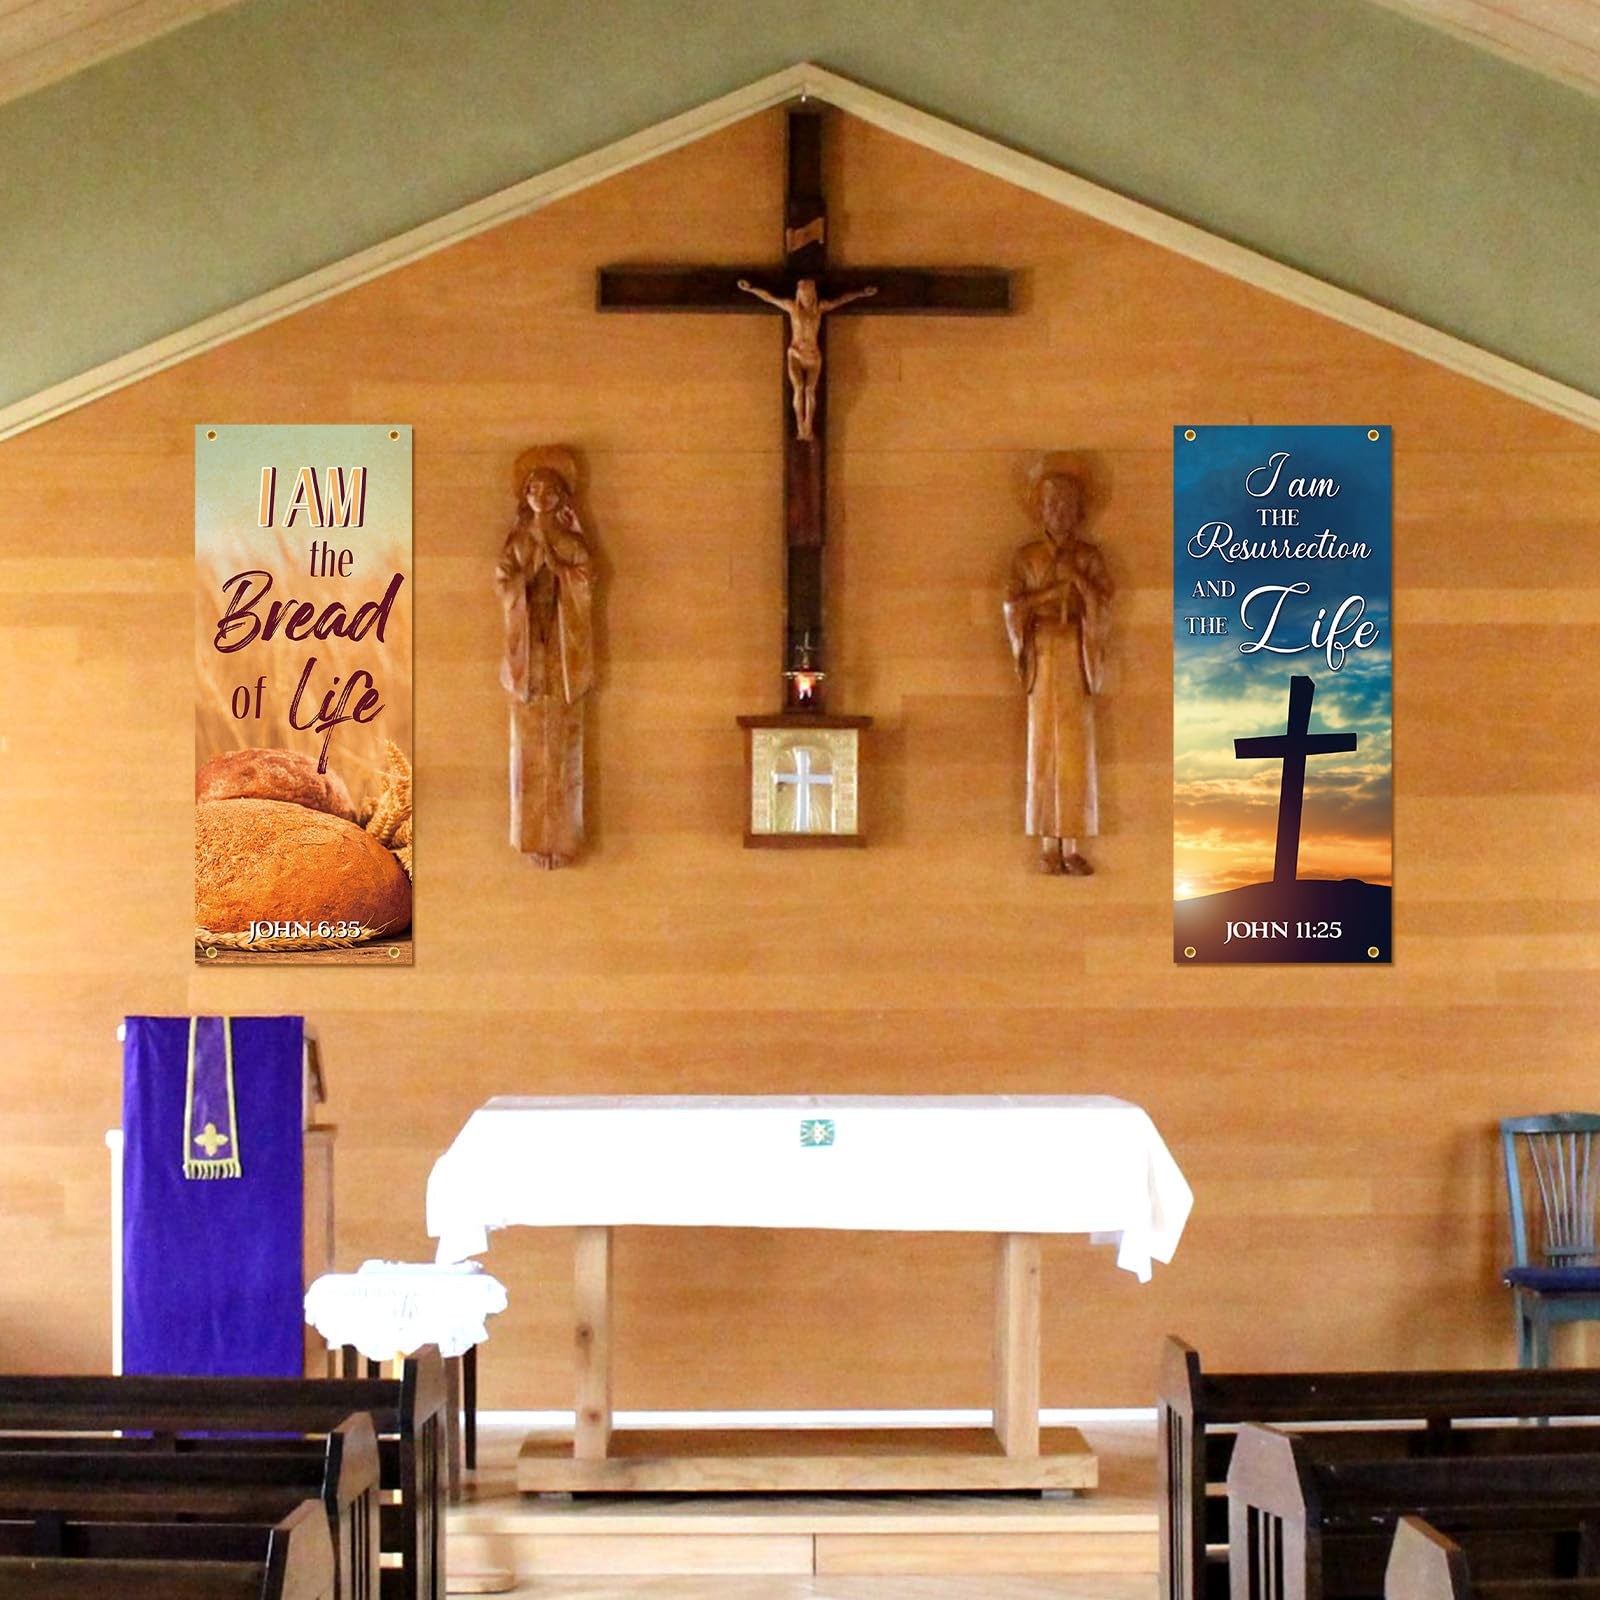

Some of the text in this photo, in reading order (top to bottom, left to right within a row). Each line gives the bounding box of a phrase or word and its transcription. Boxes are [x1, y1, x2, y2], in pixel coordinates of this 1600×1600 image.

[1245, 452, 1340, 498] I am
[257, 466, 368, 528] I AM
[1256, 508, 1300, 527] THE
[309, 539, 354, 578] the
[1187, 521, 1372, 563] Resurrection
[1191, 580, 1236, 598] AND
[213, 570, 405, 654] Bread
[1184, 582, 1379, 671] THE Life
[231, 657, 386, 775] of Life
[247, 920, 362, 944] JOHN 6:35
[1223, 921, 1343, 945] JOHN 11:25
